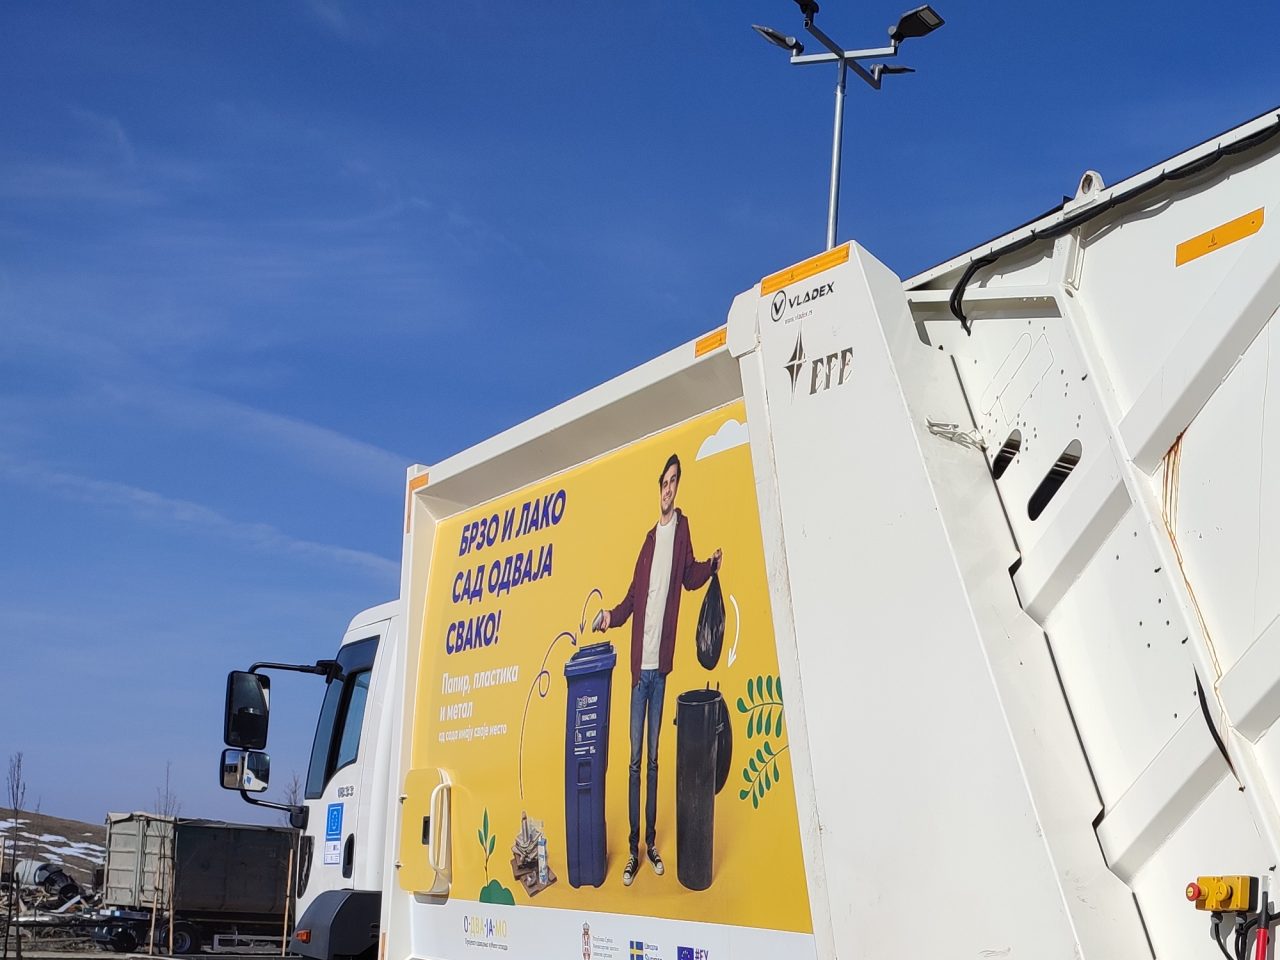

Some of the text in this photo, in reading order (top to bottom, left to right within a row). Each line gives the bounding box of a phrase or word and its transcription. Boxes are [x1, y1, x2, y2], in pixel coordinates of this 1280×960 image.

[788, 281, 835, 309] VLADEX
[809, 347, 854, 395] EFE
[459, 489, 567, 557] БРЗО И ЛАКО
[452, 543, 553, 605] САД ОДВАЈА
[446, 610, 502, 655] СВАКО!
[441, 665, 519, 696] Папир, пластика
[440, 702, 473, 721] и метал
